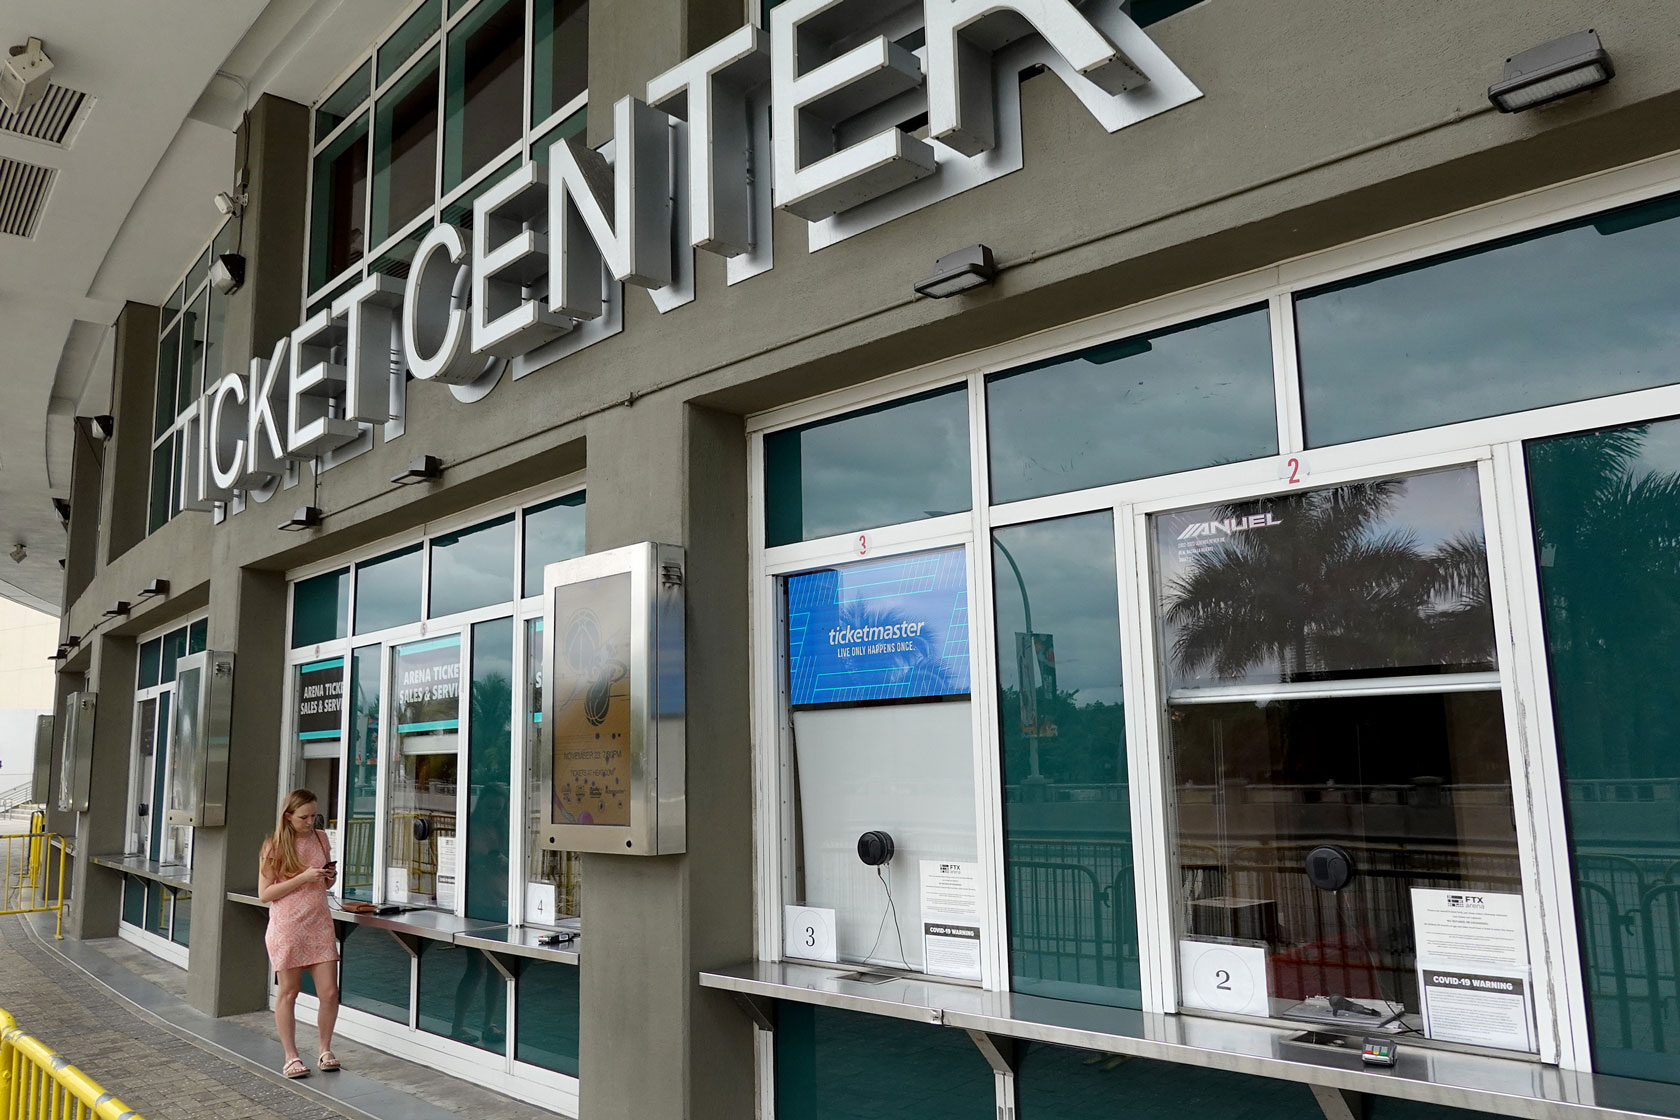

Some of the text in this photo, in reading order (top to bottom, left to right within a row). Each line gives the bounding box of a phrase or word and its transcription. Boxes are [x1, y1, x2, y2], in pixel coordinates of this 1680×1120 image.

[177, 271, 392, 512] TICKET
[1287, 458, 1300, 484] 2
[859, 535, 867, 555] 3
[828, 620, 925, 646] ticketmaster
[837, 647, 850, 658] LIVE
[851, 645, 866, 657] ONLY
[867, 642, 896, 655] HAPPENS
[404, 669, 430, 685] ARENA
[303, 685, 324, 698] ARENA
[400, 683, 460, 704] SALES & SERVI
[300, 700, 317, 714] SALES
[319, 700, 324, 713] &
[536, 899, 543, 916] 4
[1465, 895, 1484, 904] FTX
[805, 926, 815, 947] 3
[1215, 969, 1232, 991] 2
[1432, 975, 1514, 991] COVID-19 WARNING
